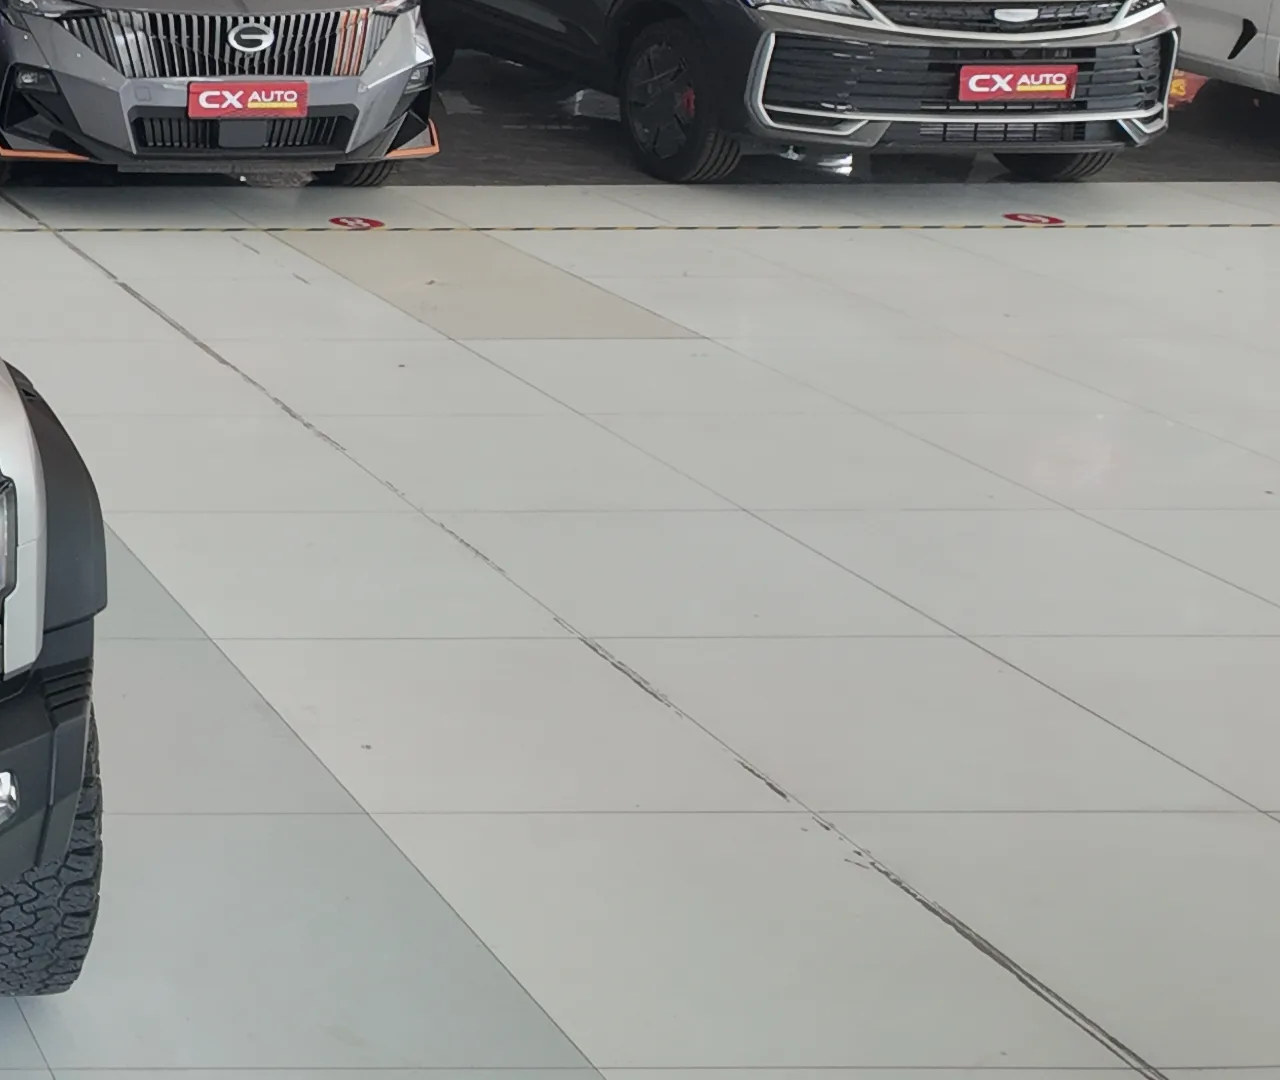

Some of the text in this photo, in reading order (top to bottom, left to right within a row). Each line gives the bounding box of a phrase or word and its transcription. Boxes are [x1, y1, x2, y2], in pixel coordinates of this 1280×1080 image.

[968, 73, 1067, 92] CX AUTO
[198, 90, 298, 109] CX AUTO
